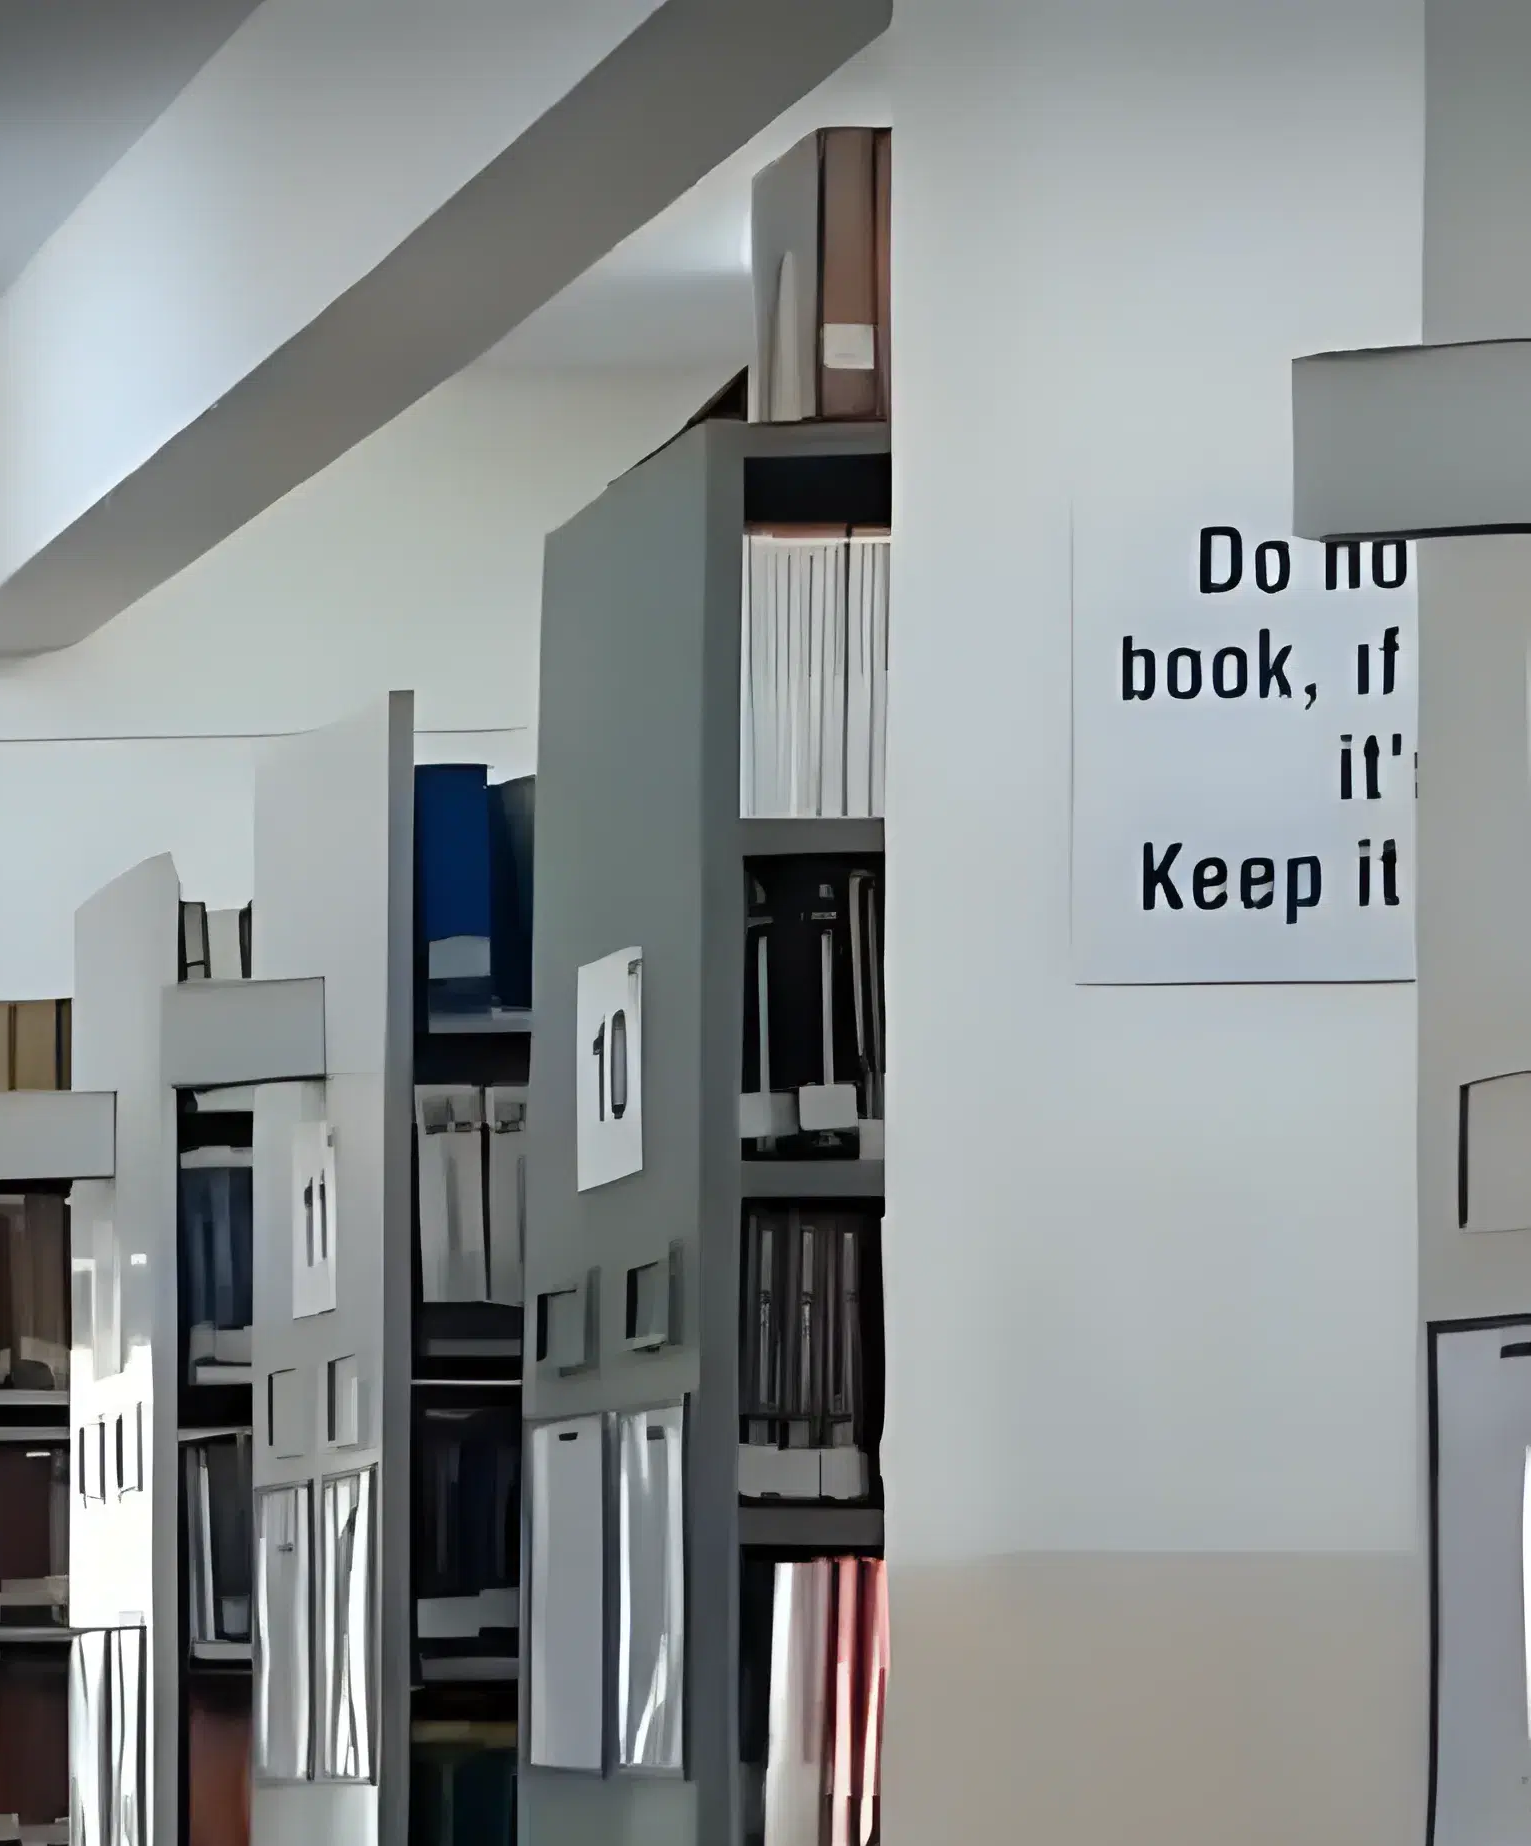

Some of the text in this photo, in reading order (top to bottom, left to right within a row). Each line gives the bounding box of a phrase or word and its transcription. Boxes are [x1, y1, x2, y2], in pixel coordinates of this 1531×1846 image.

[1199, 526, 1291, 594] Do
[1122, 626, 1400, 711] book, if
[1339, 732, 1419, 800] it'
[1143, 838, 1400, 924] Keep it
[593, 1008, 628, 1122] 10
